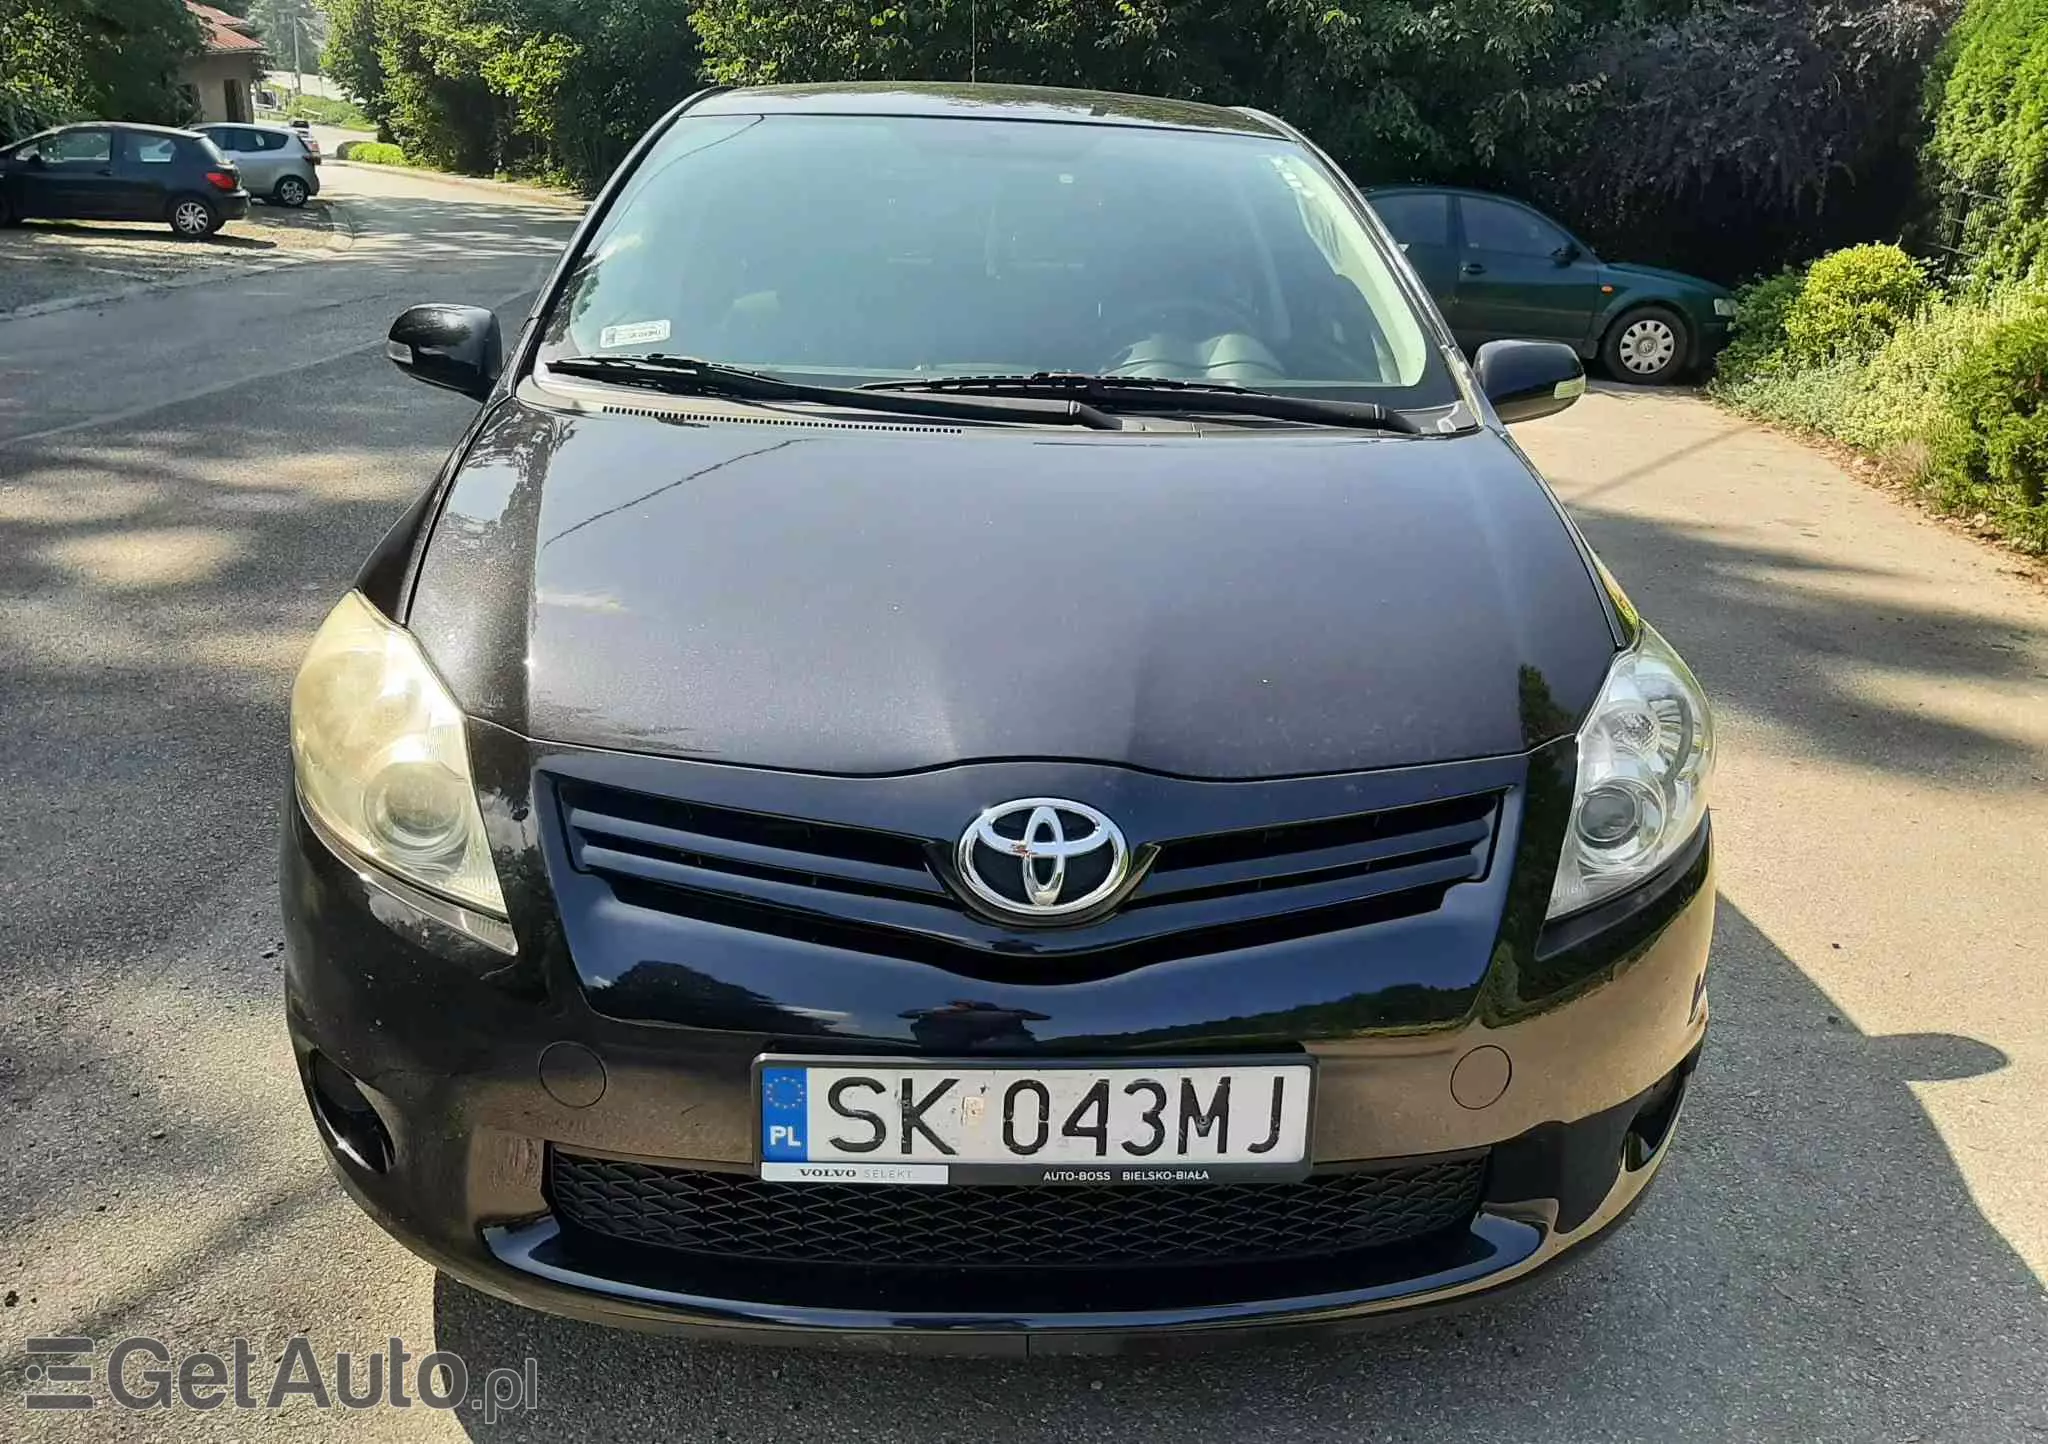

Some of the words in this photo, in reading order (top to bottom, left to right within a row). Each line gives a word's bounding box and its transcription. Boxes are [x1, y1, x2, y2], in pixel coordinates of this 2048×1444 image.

[827, 1076, 960, 1156] SK
[1002, 1076, 1285, 1156] 043MJ
[770, 1126, 801, 1147] PL
[800, 1168, 857, 1178] VOLVO
[864, 1167, 913, 1179] SELEKT
[1043, 1170, 1111, 1182] AUTO-BOSS
[1122, 1169, 1210, 1181] BIELSKO-BIAŁA
